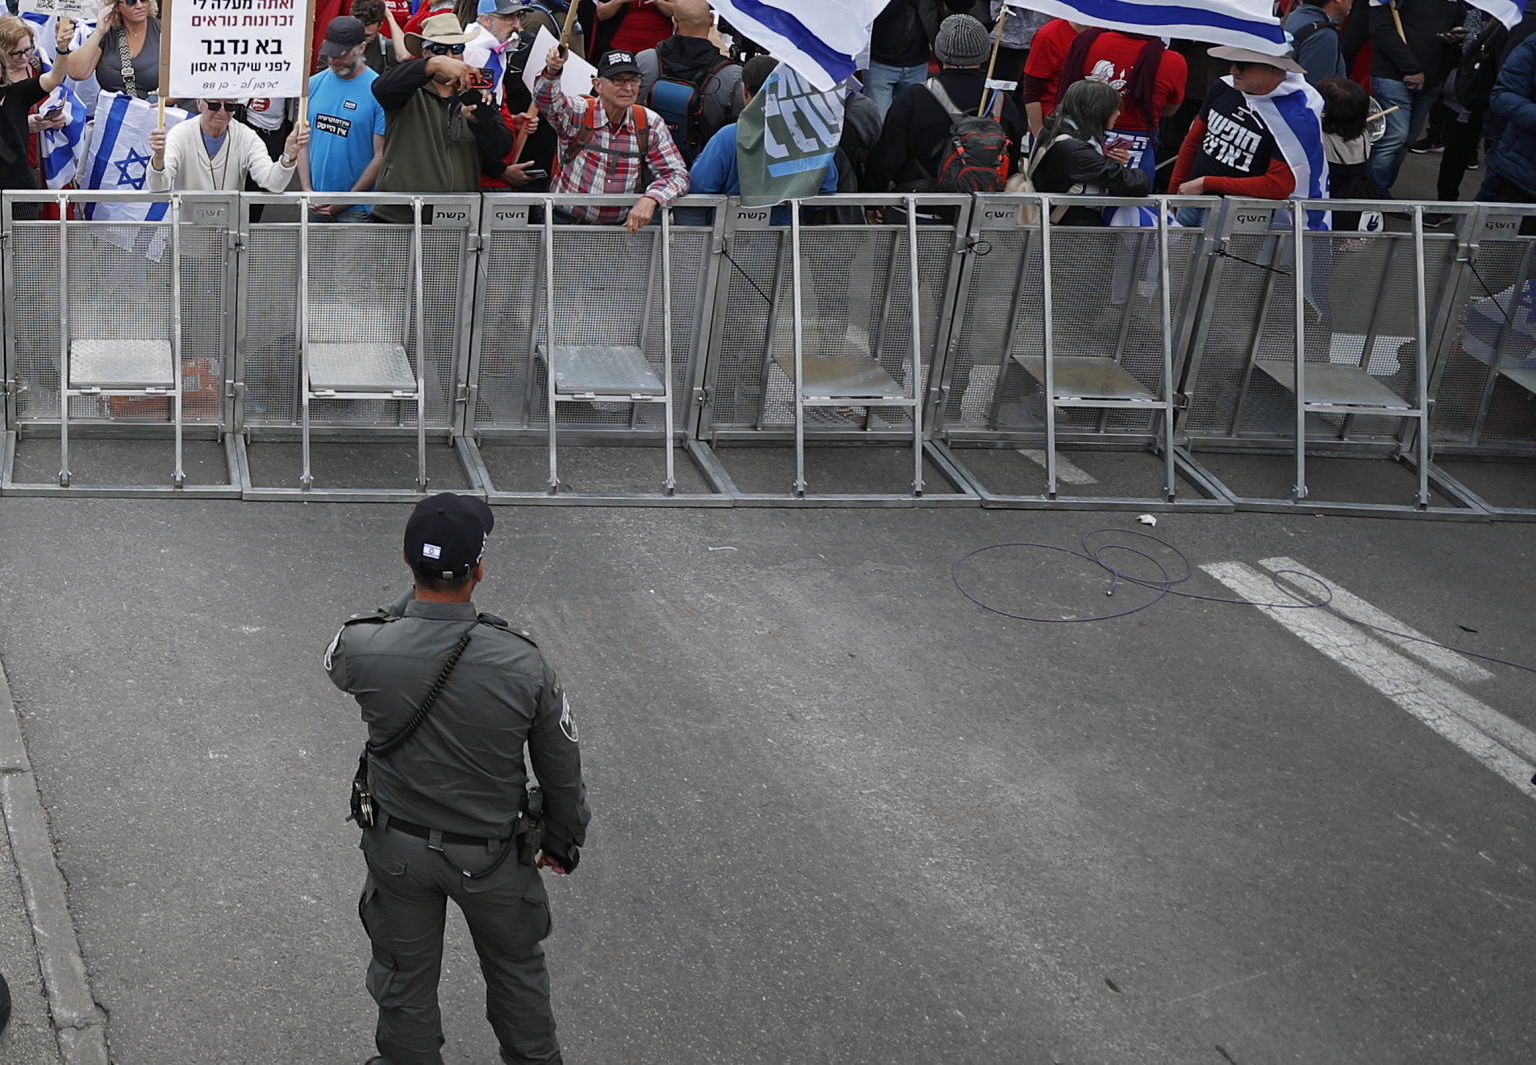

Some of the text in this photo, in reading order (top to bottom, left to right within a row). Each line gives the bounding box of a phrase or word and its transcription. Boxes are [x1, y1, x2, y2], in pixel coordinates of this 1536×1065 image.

[192, 15, 294, 27] זכרונות נוראים
[201, 39, 282, 55] בא נדבר
[190, 61, 291, 75] לפני שיקרה אסון
[436, 211, 466, 221] קשת
[737, 211, 768, 221] קשת
